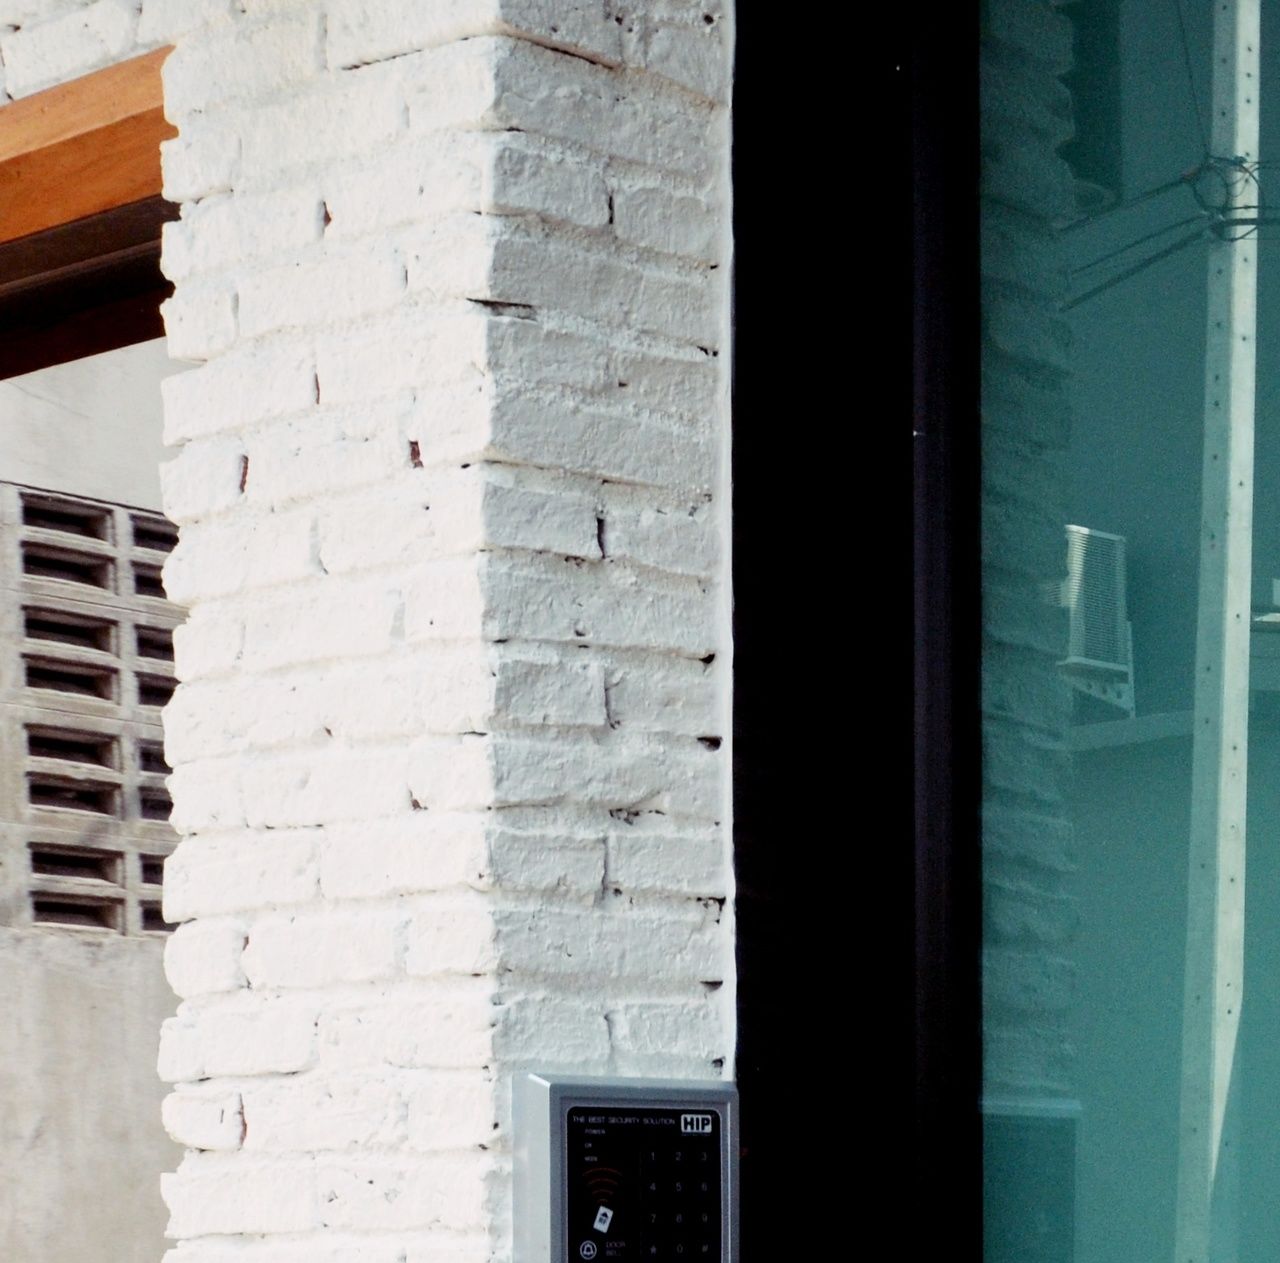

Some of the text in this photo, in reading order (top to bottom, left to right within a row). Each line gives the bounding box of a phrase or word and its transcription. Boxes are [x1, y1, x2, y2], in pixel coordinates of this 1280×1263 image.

[588, 1115, 605, 1124] BEST
[608, 1116, 640, 1124] SECURITY
[642, 1117, 675, 1125] SOLUTION
[683, 1117, 710, 1131] HIP
